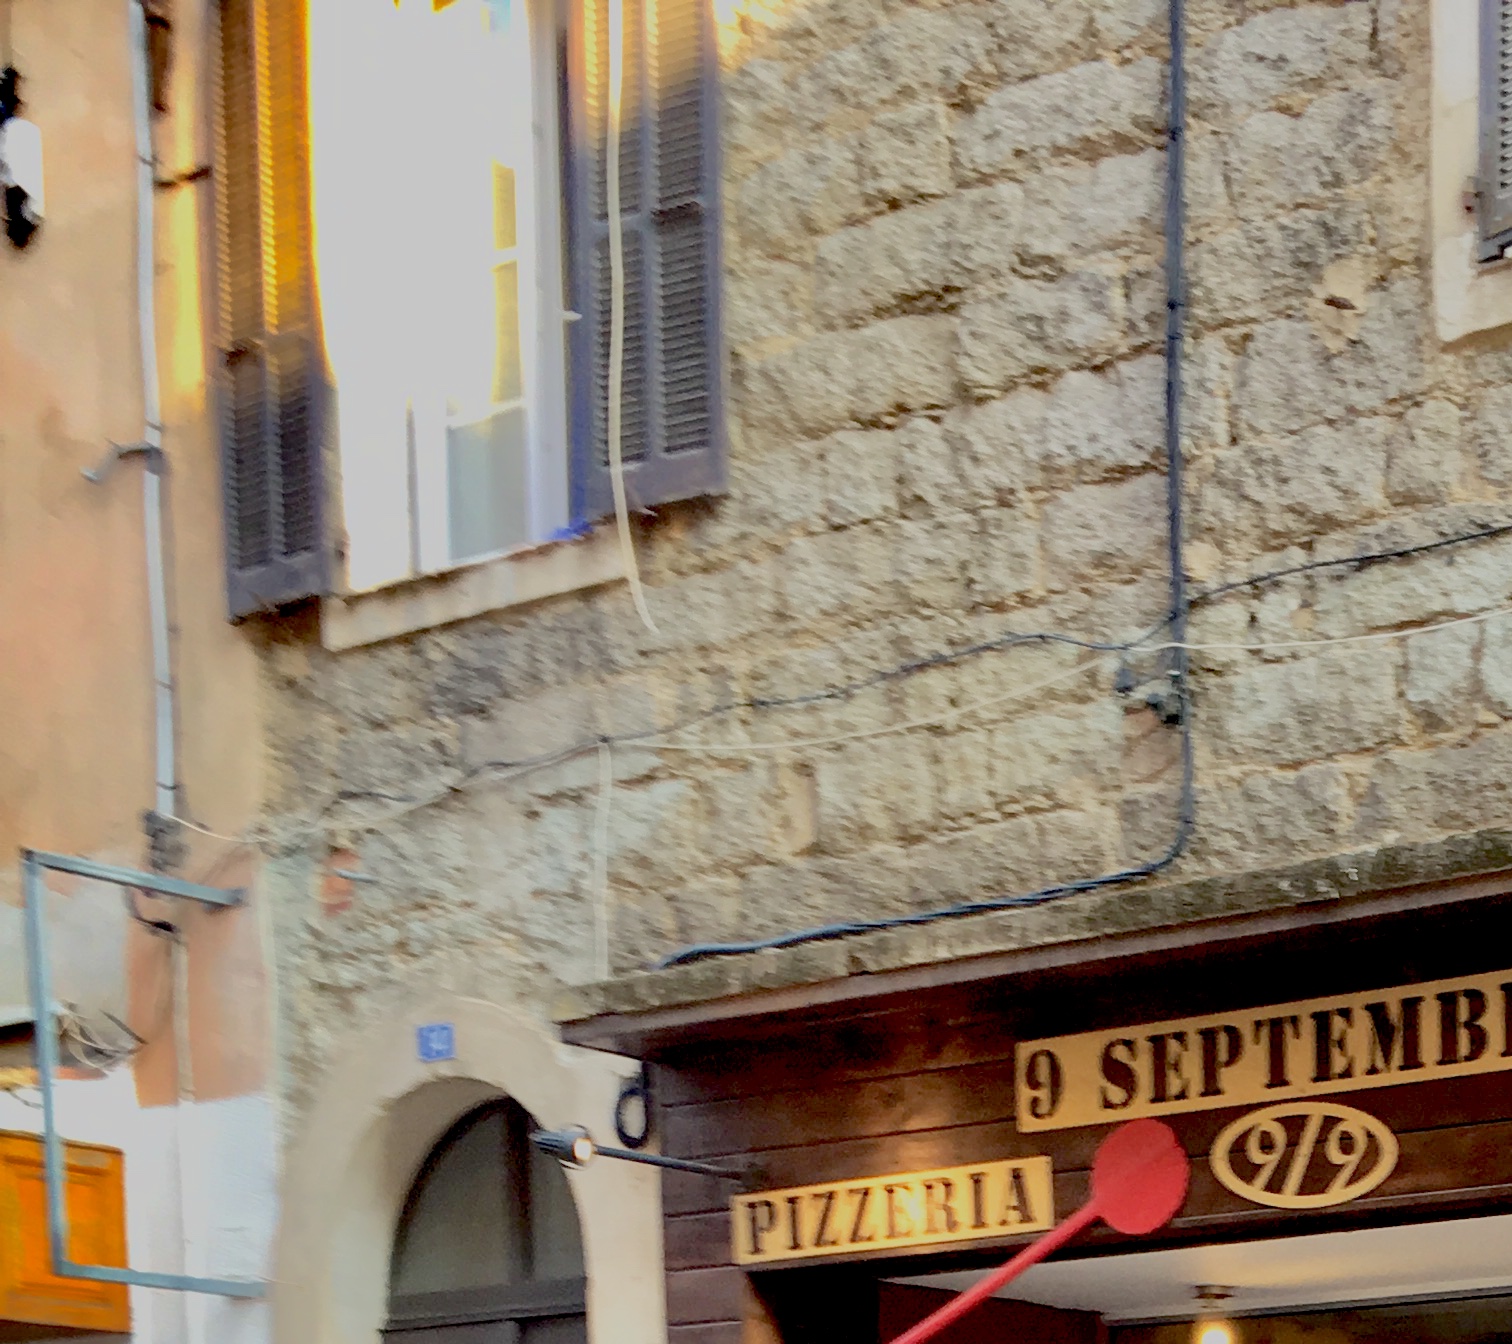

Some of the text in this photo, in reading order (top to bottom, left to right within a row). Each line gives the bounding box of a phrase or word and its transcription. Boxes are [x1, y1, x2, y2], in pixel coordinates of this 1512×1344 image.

[1025, 1049, 1063, 1119] 9
[1246, 1113, 1368, 1196] 9/9
[748, 1167, 1037, 1255] PIZZERIA
